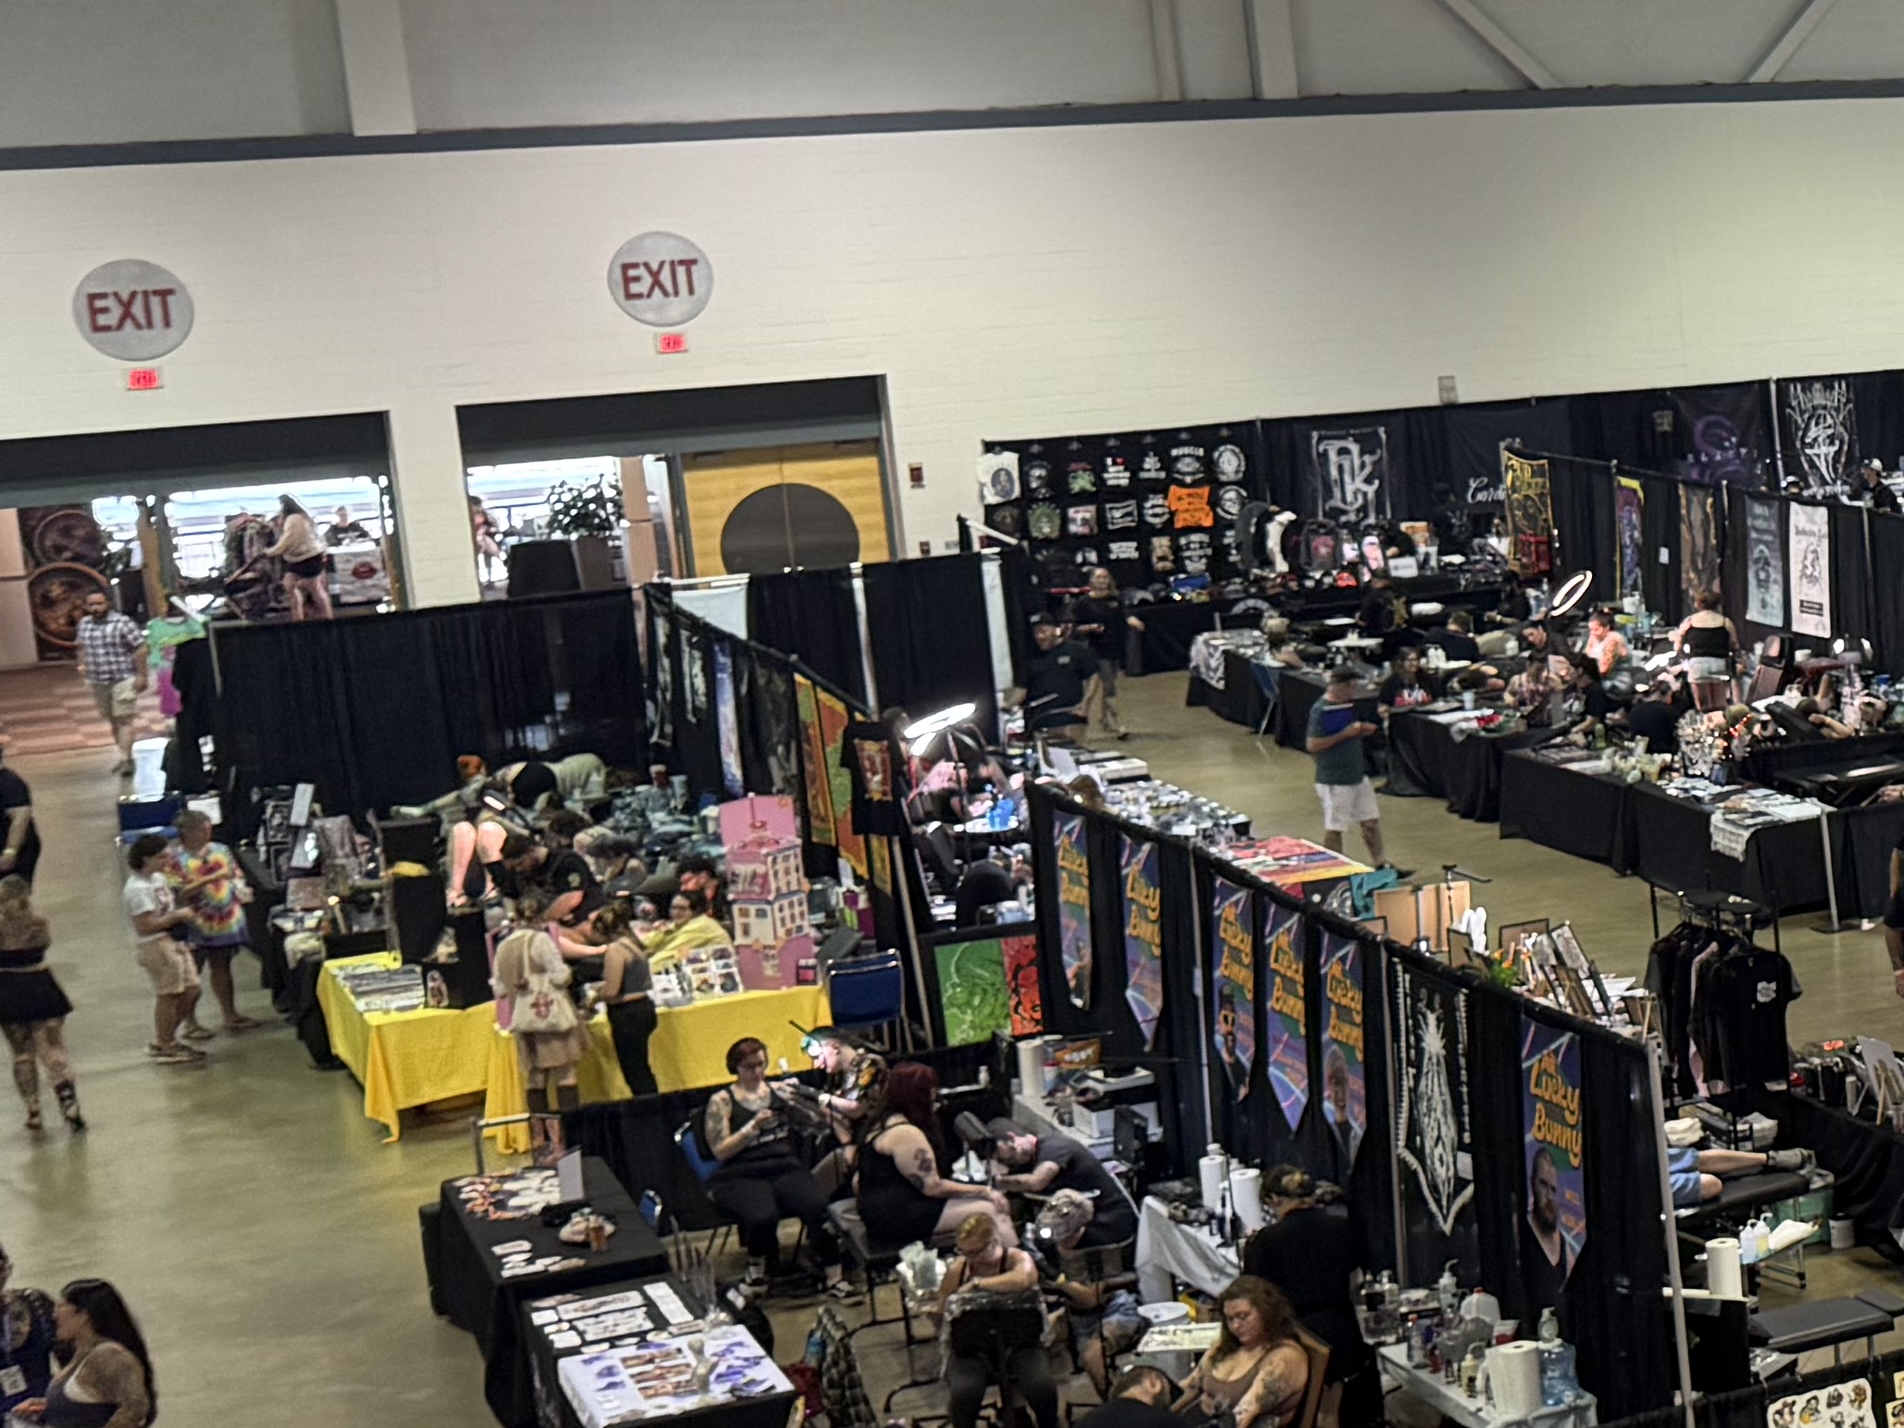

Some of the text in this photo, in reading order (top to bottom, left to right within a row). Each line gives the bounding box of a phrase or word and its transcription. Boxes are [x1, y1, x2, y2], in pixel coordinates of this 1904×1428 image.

[620, 258, 698, 301] EXIT
[86, 288, 177, 333] EXIT
[1530, 1060, 1581, 1126] Lucky
[1533, 1102, 1583, 1168] Bunny
